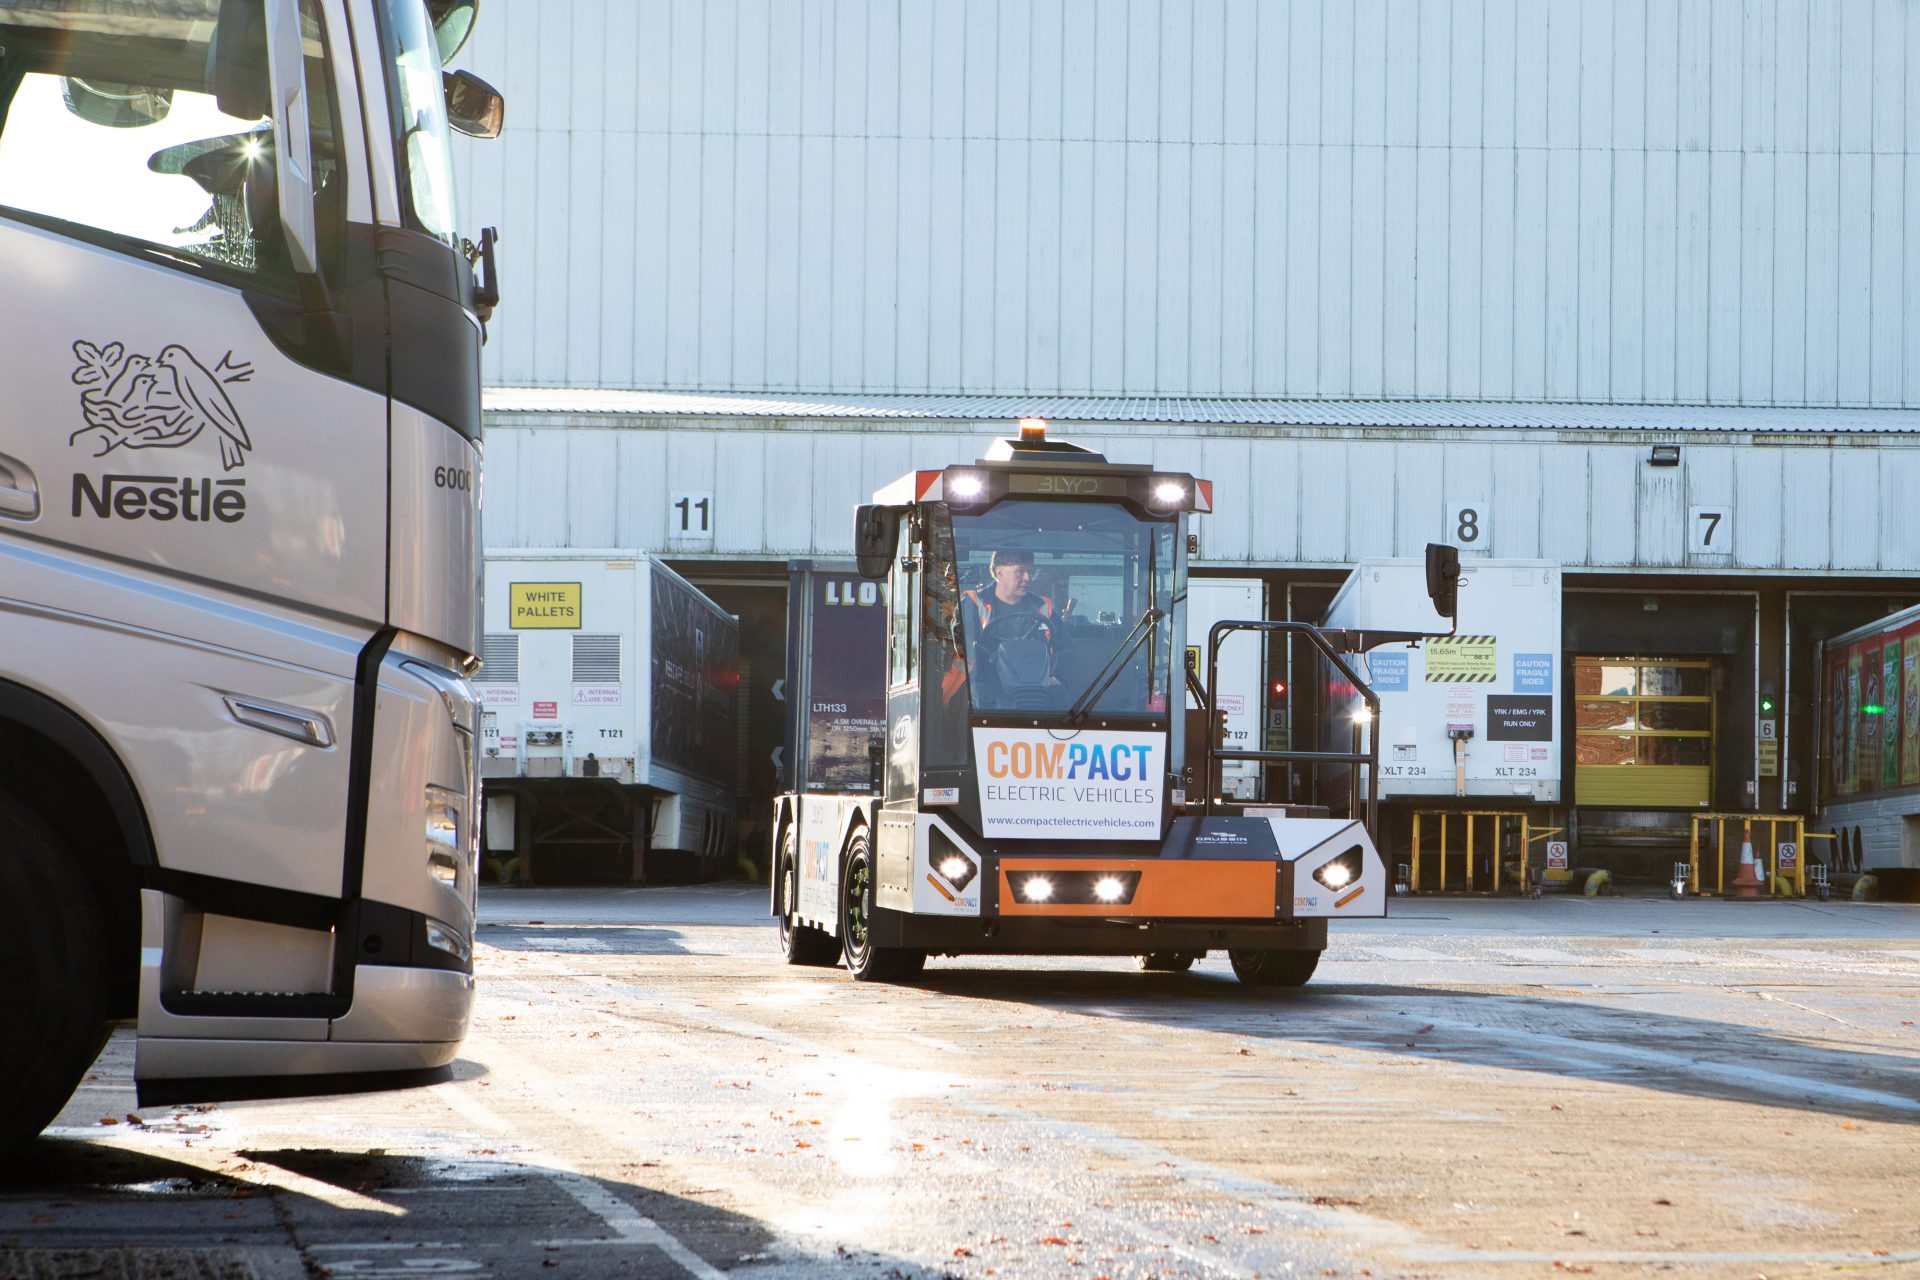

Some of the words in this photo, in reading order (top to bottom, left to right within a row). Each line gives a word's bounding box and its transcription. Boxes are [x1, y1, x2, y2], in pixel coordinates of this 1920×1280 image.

[71, 473, 246, 523] Nestlé
[675, 498, 708, 531] 11
[1458, 508, 1479, 542] 8
[1700, 513, 1721, 545] 7
[526, 592, 566, 601] WHITE
[517, 607, 575, 616] PALLETS
[1516, 669, 1549, 677] FRAGILE
[813, 703, 847, 713] LTH133
[608, 729, 623, 738] 121
[1763, 723, 1772, 736] 6
[1234, 731, 1248, 740] 127
[987, 741, 1152, 781] COMPACT
[1384, 766, 1403, 775] XLT
[1408, 766, 1426, 776] 234
[1495, 767, 1514, 776] XLT
[1518, 767, 1537, 776] 234
[987, 785, 1065, 802] ELECTRIC
[1073, 787, 1154, 804] VEHICLES
[988, 816, 1155, 828] www.compactelectricvehicles.com
